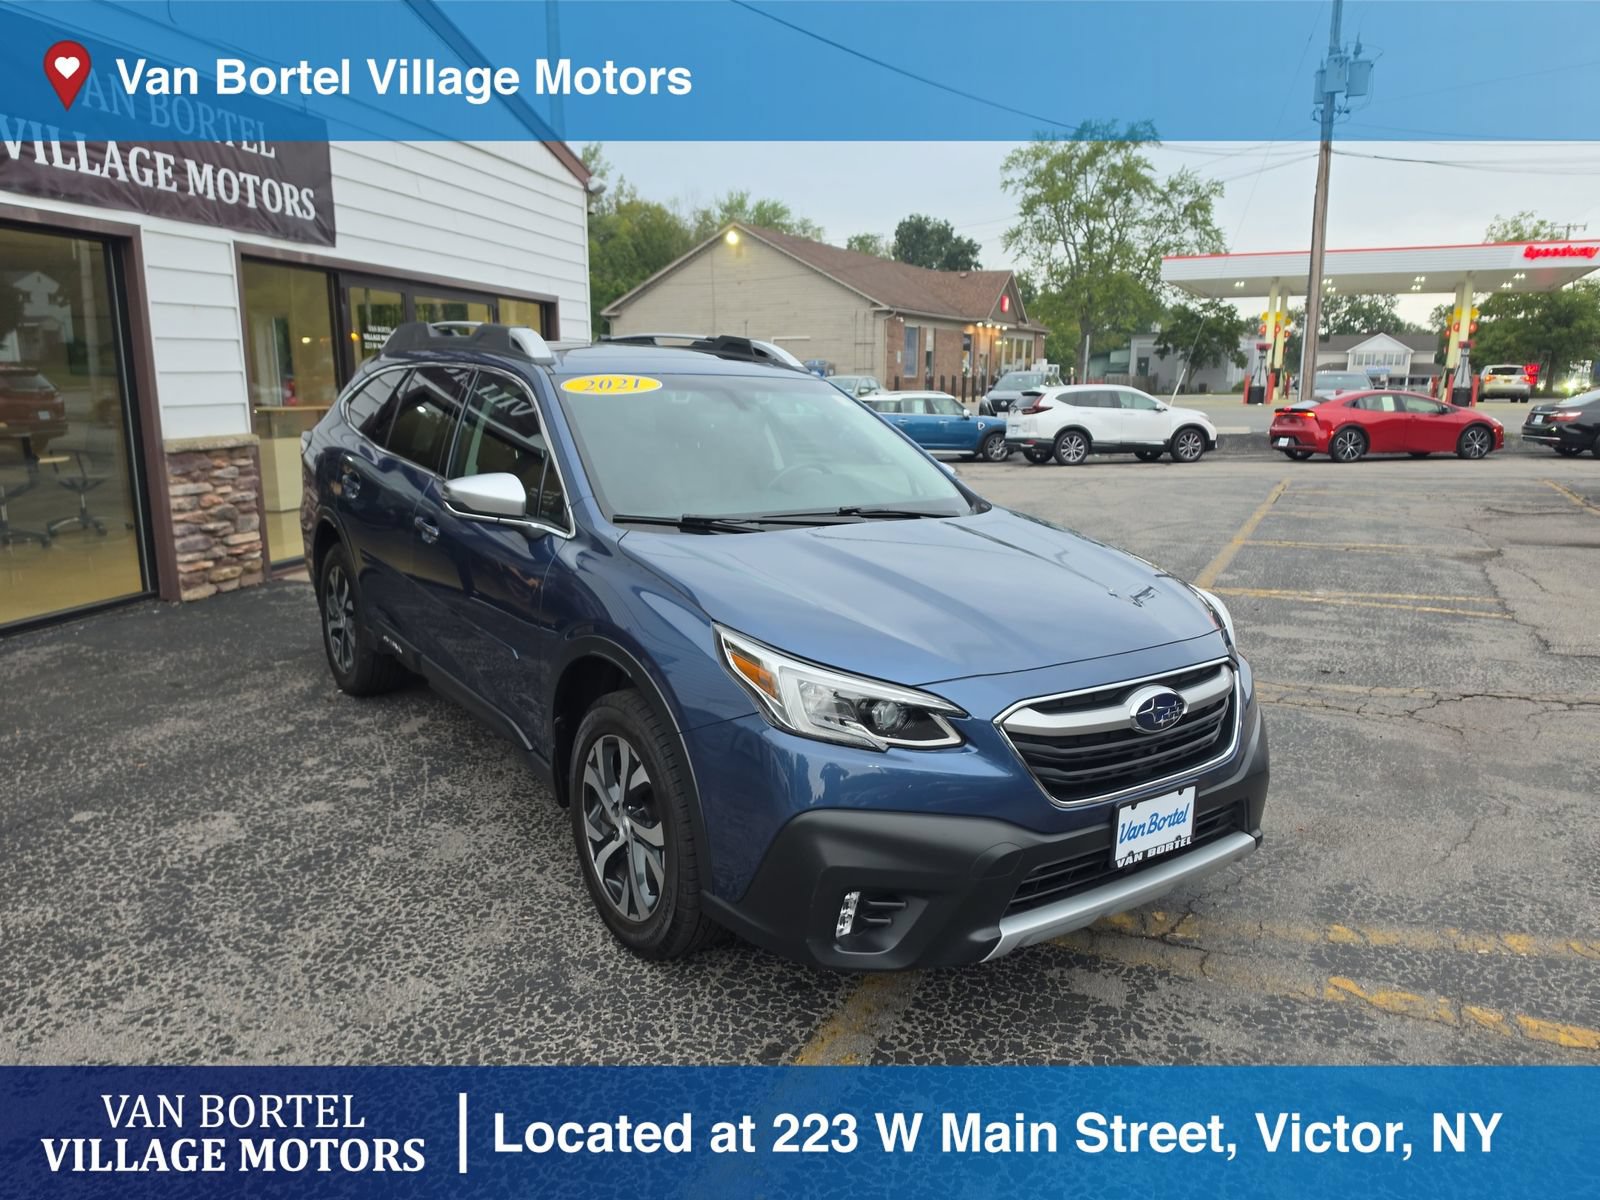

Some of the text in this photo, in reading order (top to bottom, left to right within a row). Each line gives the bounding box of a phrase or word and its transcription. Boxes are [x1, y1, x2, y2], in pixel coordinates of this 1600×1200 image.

[80, 67, 275, 159] AN BORTEL
[0, 113, 316, 221] VILLAGE MOTORS
[1523, 245, 1599, 259] Speedway
[583, 377, 640, 391] 2021
[1119, 802, 1190, 845] Van Bortel
[1116, 836, 1193, 868] VAN BORTEL
